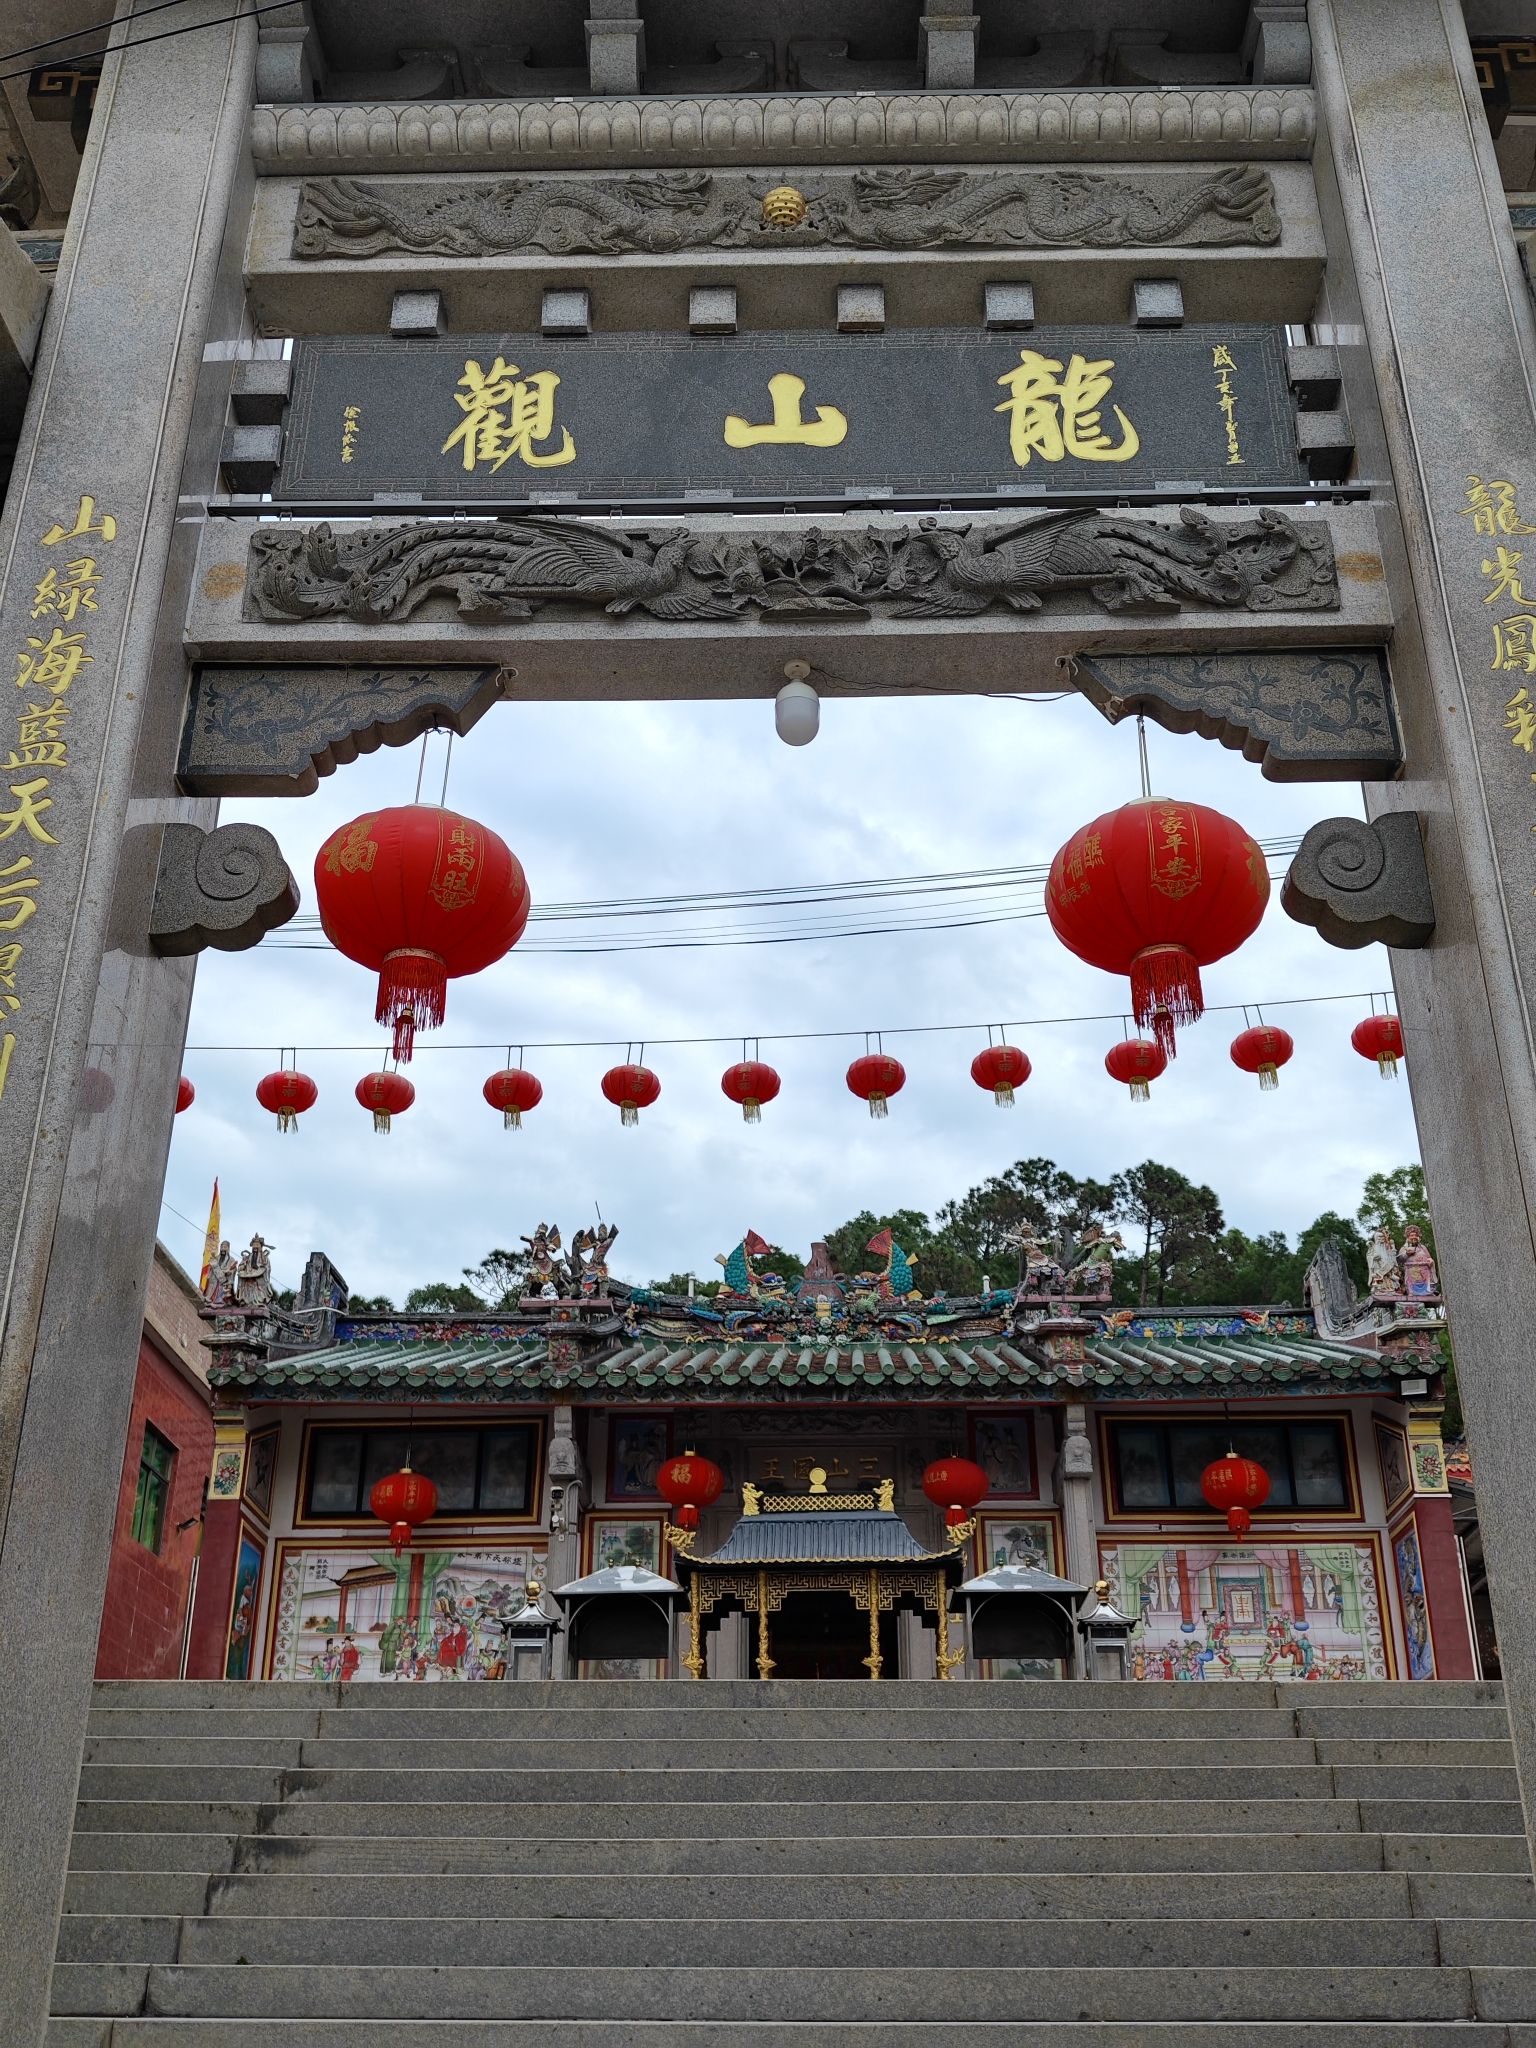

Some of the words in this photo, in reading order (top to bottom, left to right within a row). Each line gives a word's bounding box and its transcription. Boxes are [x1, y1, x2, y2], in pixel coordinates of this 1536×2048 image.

[441, 350, 1140, 475] 龍山觀
[322, 815, 380, 877] 福
[671, 1463, 692, 1485] 福
